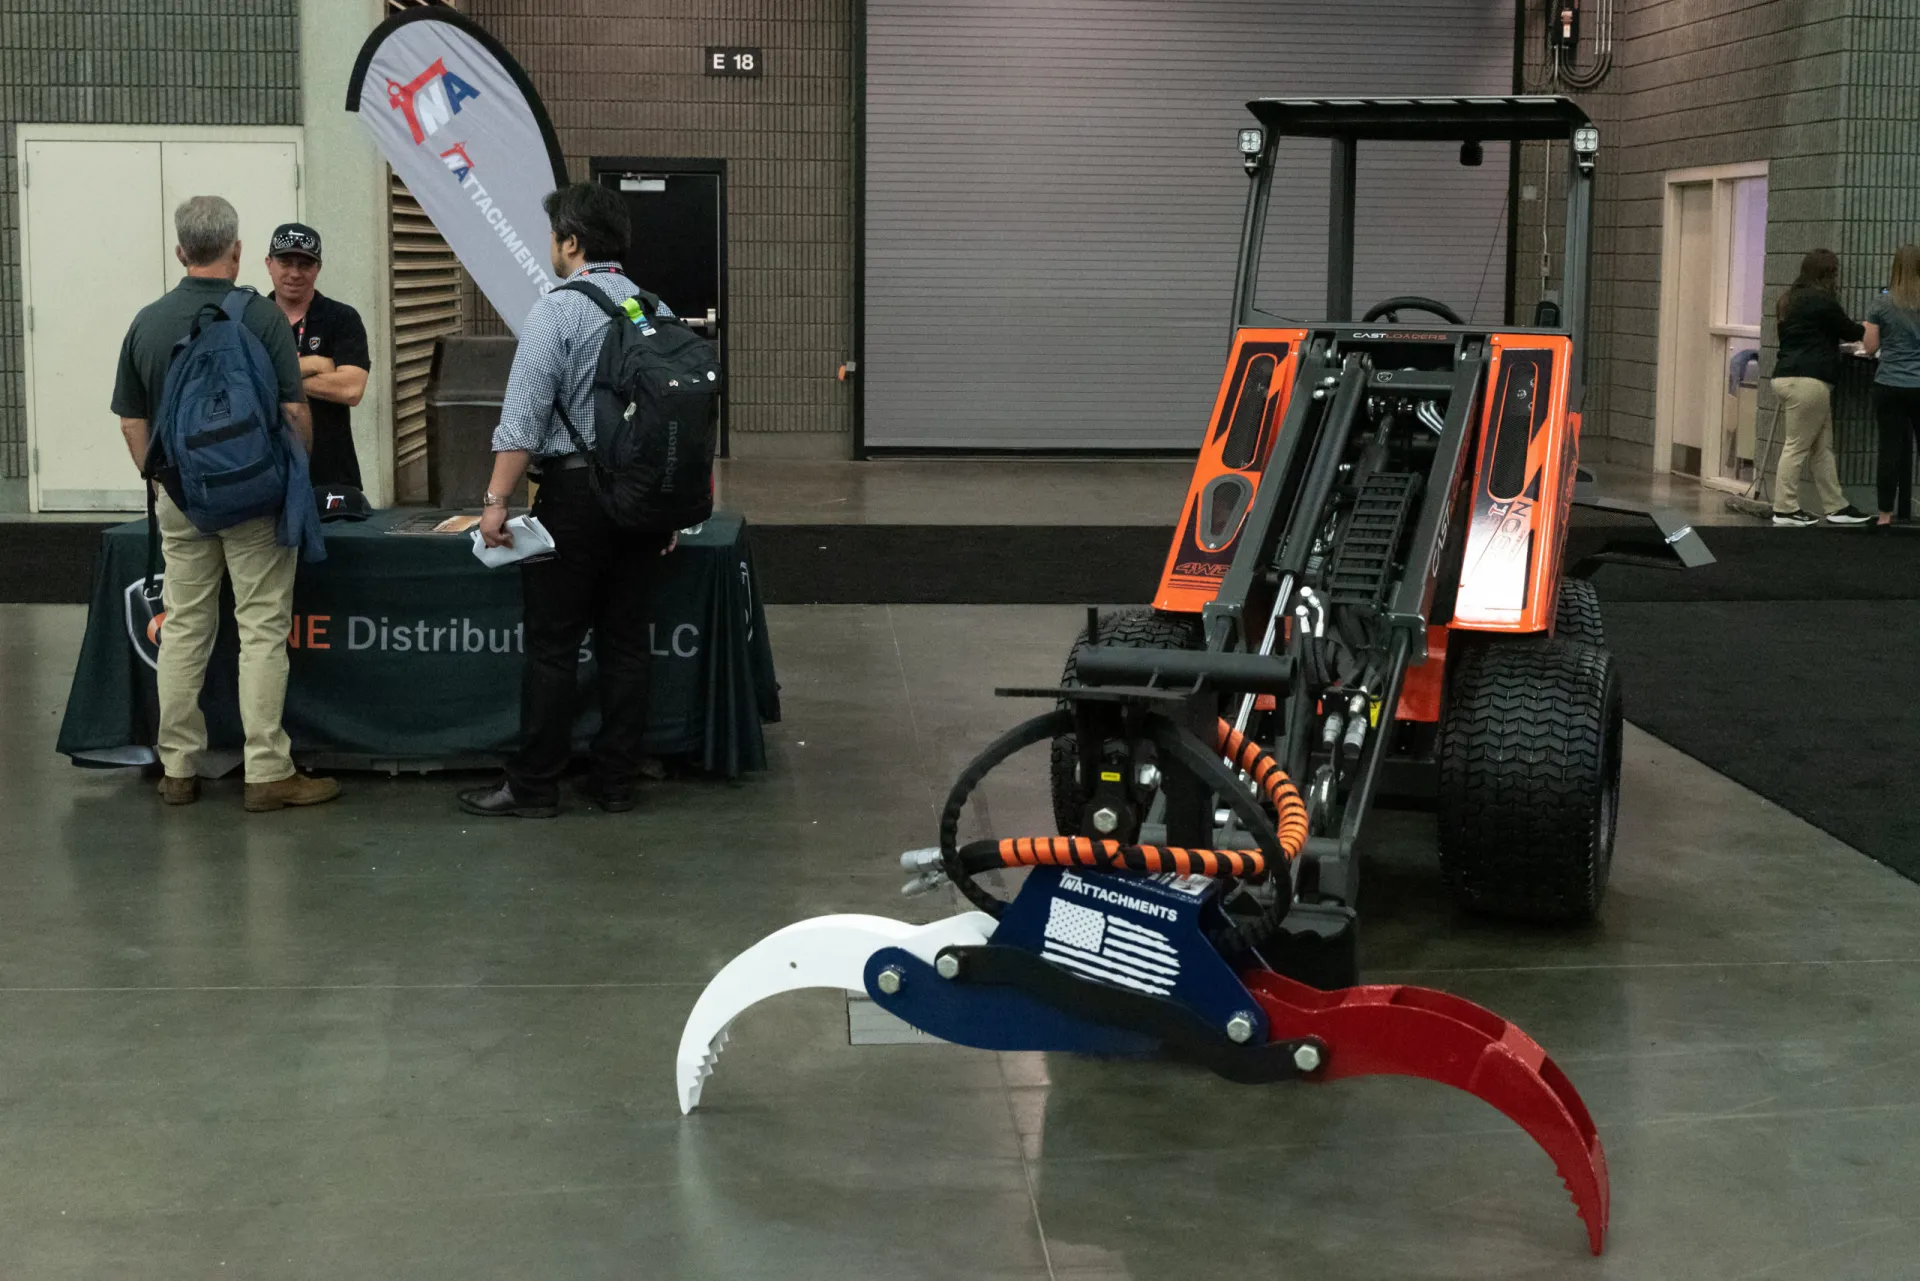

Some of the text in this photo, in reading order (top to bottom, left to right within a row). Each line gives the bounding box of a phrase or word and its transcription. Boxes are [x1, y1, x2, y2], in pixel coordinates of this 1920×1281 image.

[713, 53, 754, 71] E 18
[347, 615, 594, 663] Distributg
[647, 622, 701, 659] LC
